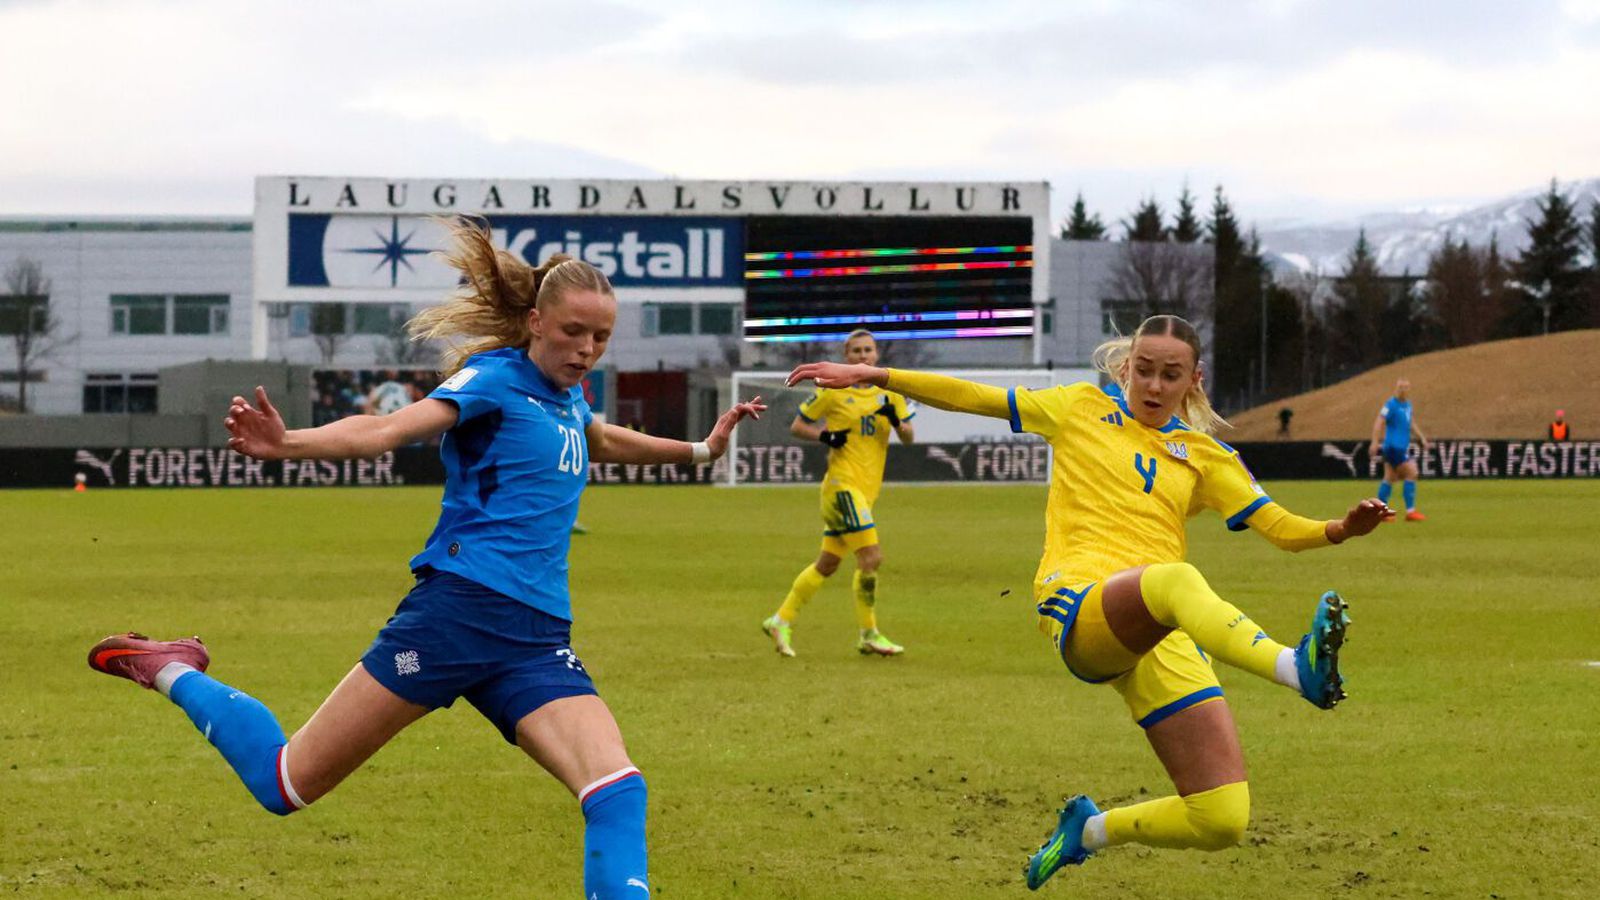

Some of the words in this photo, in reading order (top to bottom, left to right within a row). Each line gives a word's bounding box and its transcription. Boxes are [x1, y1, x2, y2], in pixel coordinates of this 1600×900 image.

[860, 415, 876, 437] 16
[128, 448, 274, 486] FOREVER.
[282, 451, 404, 486] FASTER.
[557, 424, 583, 476] 20
[976, 445, 1047, 480] FORE
[1369, 442, 1498, 477] FEVER.
[1134, 453, 1157, 494] 4
